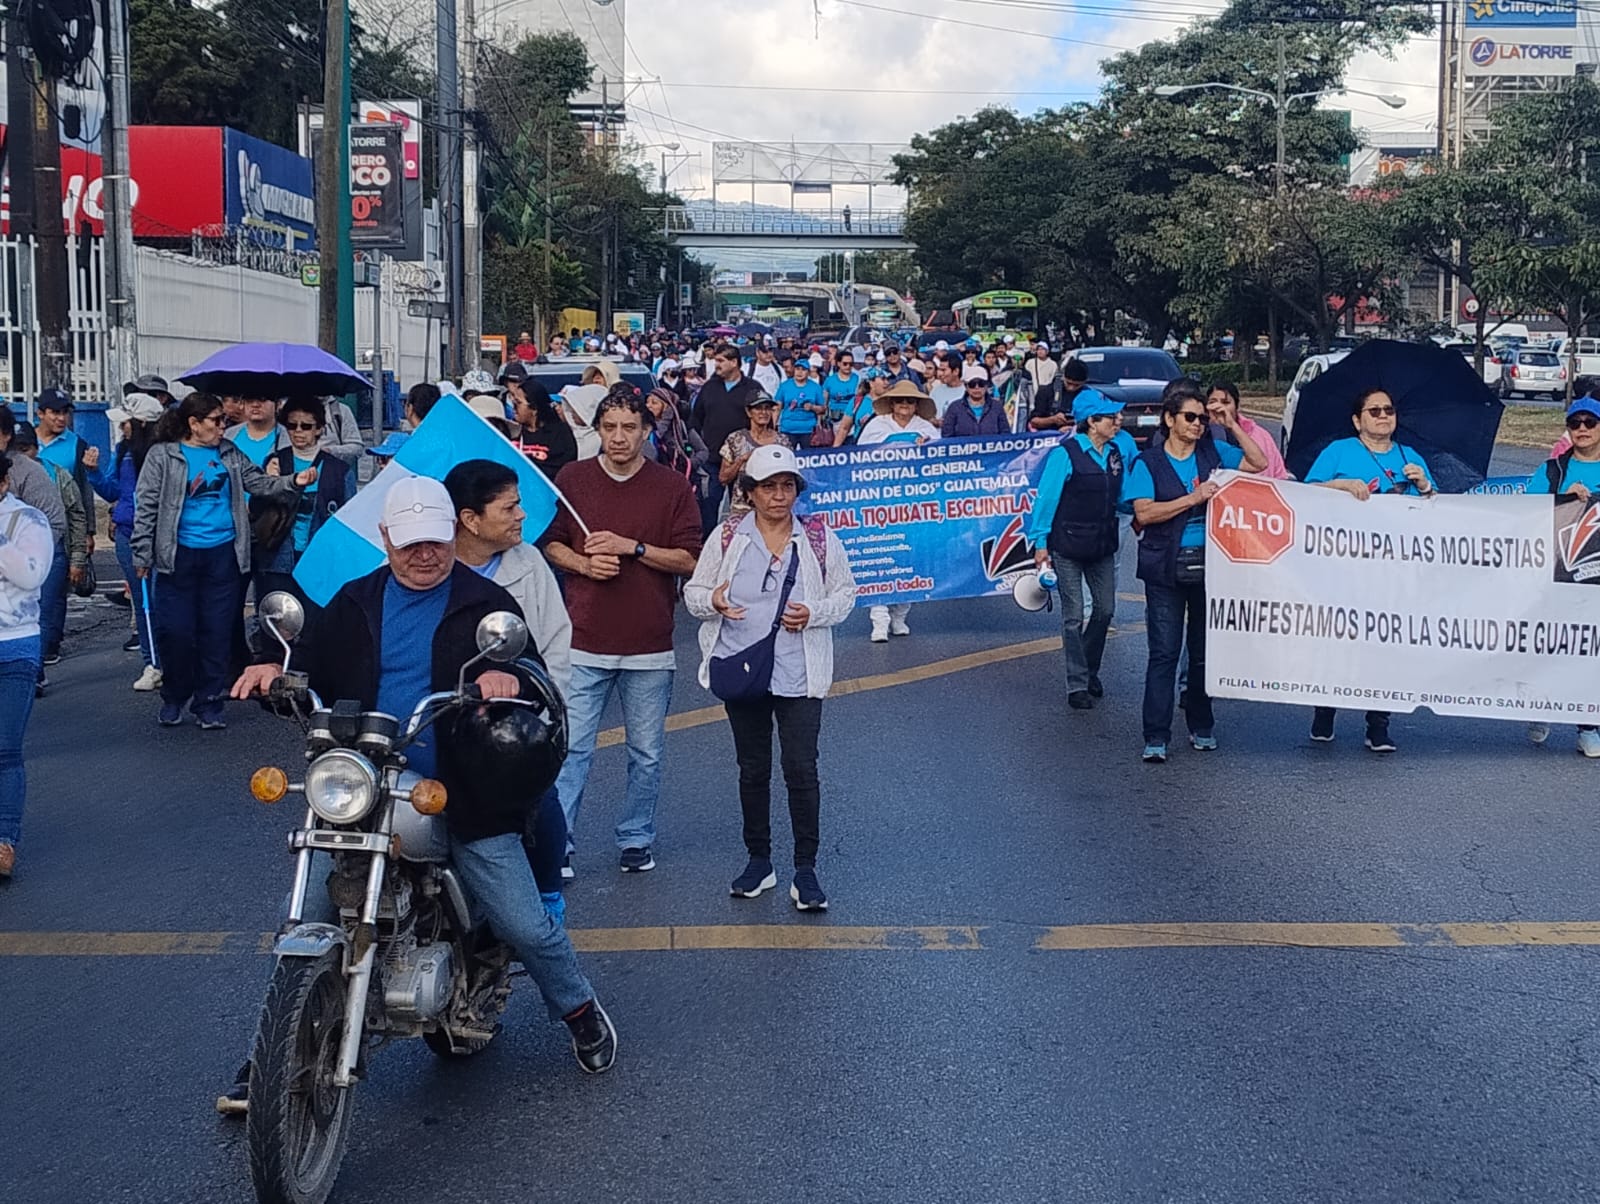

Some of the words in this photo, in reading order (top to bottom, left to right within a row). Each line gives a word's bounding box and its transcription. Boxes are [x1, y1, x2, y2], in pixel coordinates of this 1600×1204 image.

[850, 447, 925, 464] NACIONAL
[928, 446, 945, 459] DE
[948, 439, 1031, 457] EMPLEADOS
[1033, 437, 1060, 450] DEL
[851, 466, 919, 483] HOSPITAL
[921, 460, 985, 477] GENERAL
[844, 487, 881, 503] JUAN
[883, 486, 902, 499] DE
[943, 474, 1030, 492] GUATEMALA
[861, 502, 945, 527] TIQUISATE,
[1218, 505, 1284, 536] ALTO
[1304, 524, 1395, 560] DISCULPA
[1399, 534, 1435, 563] LAS
[1440, 536, 1546, 568] MOLESTIAS
[896, 577, 934, 592] todos
[1209, 598, 1359, 640] MANIFESTAMOS
[1365, 611, 1403, 644] POR
[1409, 615, 1432, 646] LA
[1438, 617, 1499, 651] SALUD
[1505, 620, 1529, 653] DE
[1218, 677, 1257, 689] FILIAL
[1261, 681, 1329, 695] HOSPITAL
[1420, 693, 1492, 707] SINDICATO
[1495, 697, 1525, 709] SAN
[1567, 702, 1585, 713] DE
